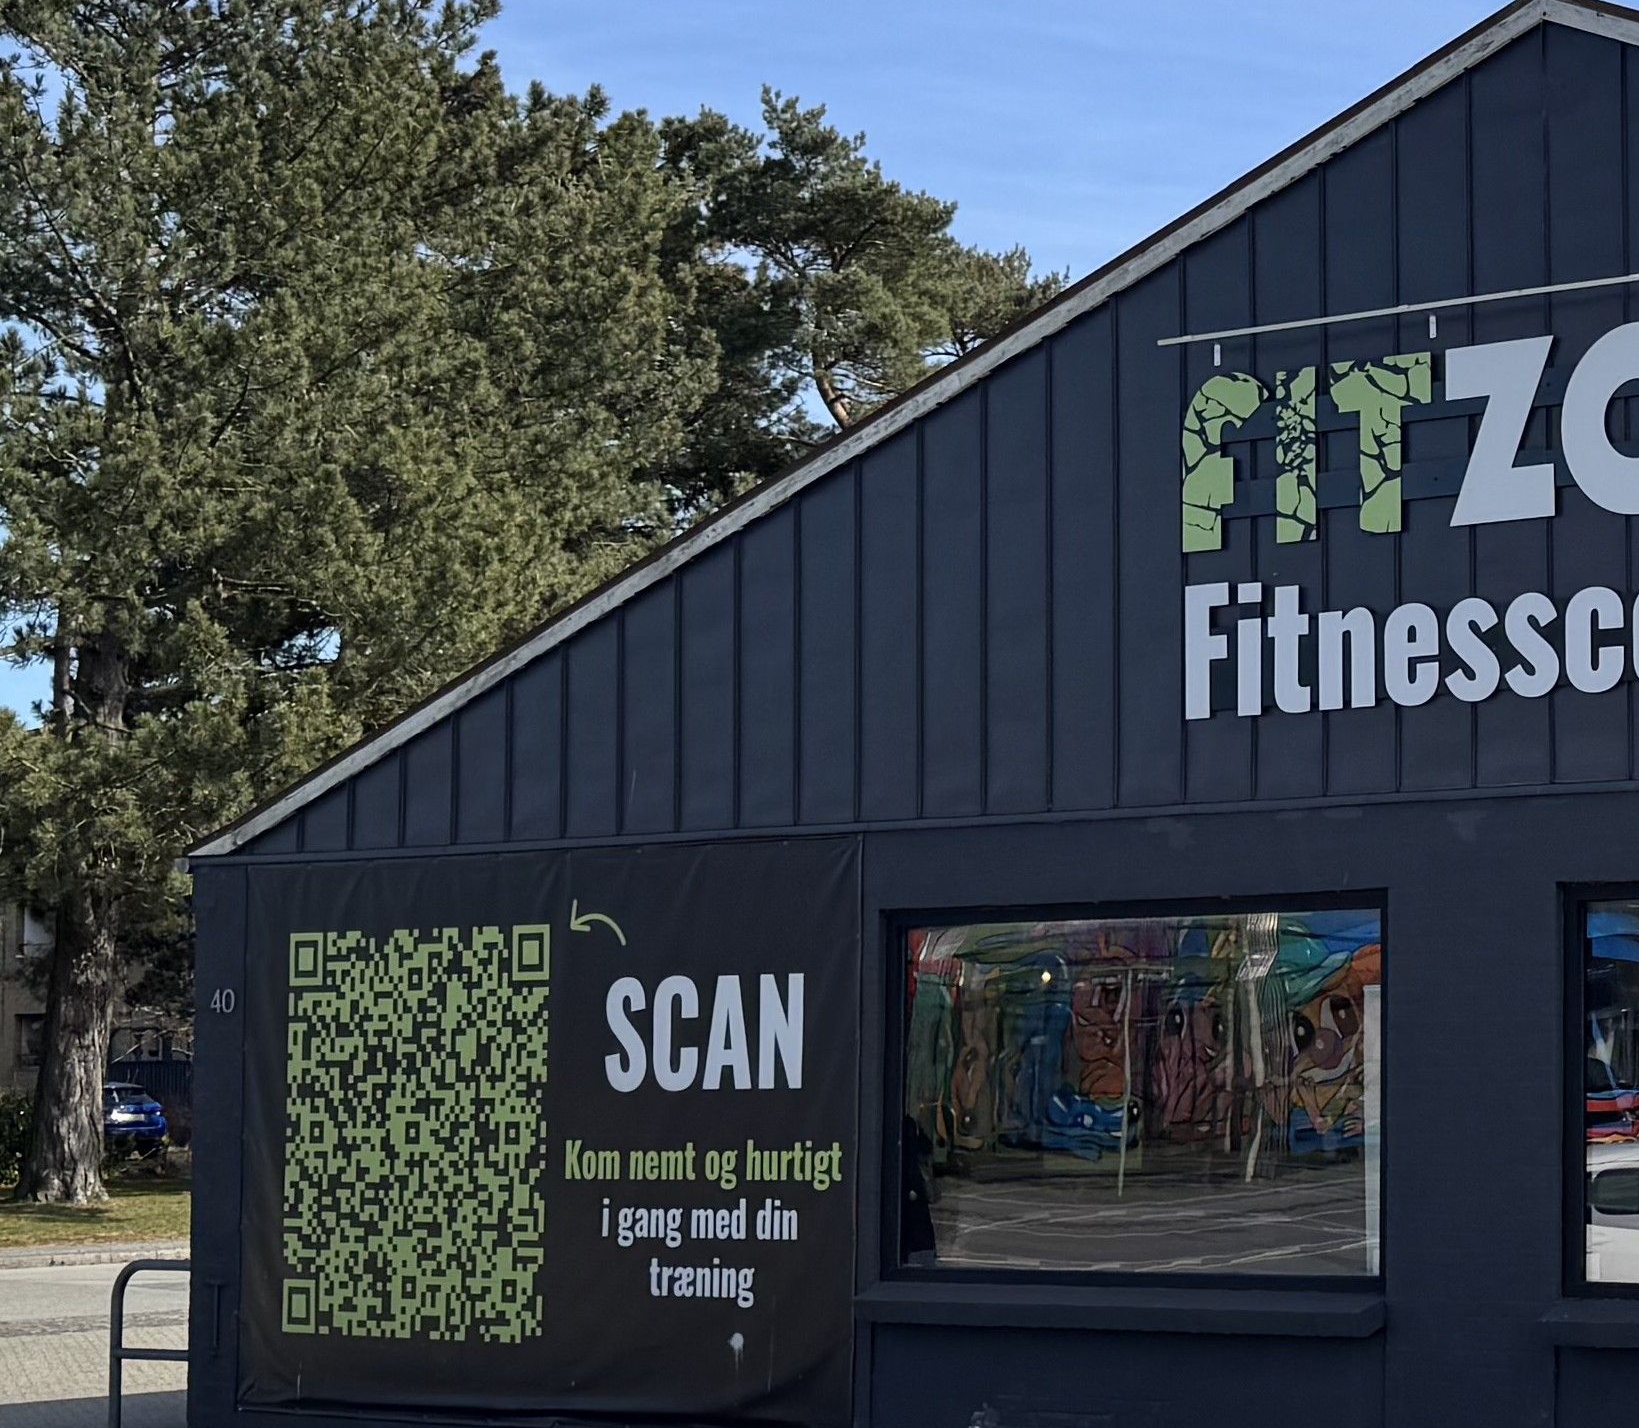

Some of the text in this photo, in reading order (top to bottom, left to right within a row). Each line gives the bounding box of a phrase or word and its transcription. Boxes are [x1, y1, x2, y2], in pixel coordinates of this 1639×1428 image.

[210, 988, 236, 1014] 40
[604, 972, 805, 1093] SCAN
[564, 1139, 843, 1191] Kom nemt og hurtigt
[601, 1197, 798, 1248] i gang med din
[649, 1257, 755, 1309] træning
